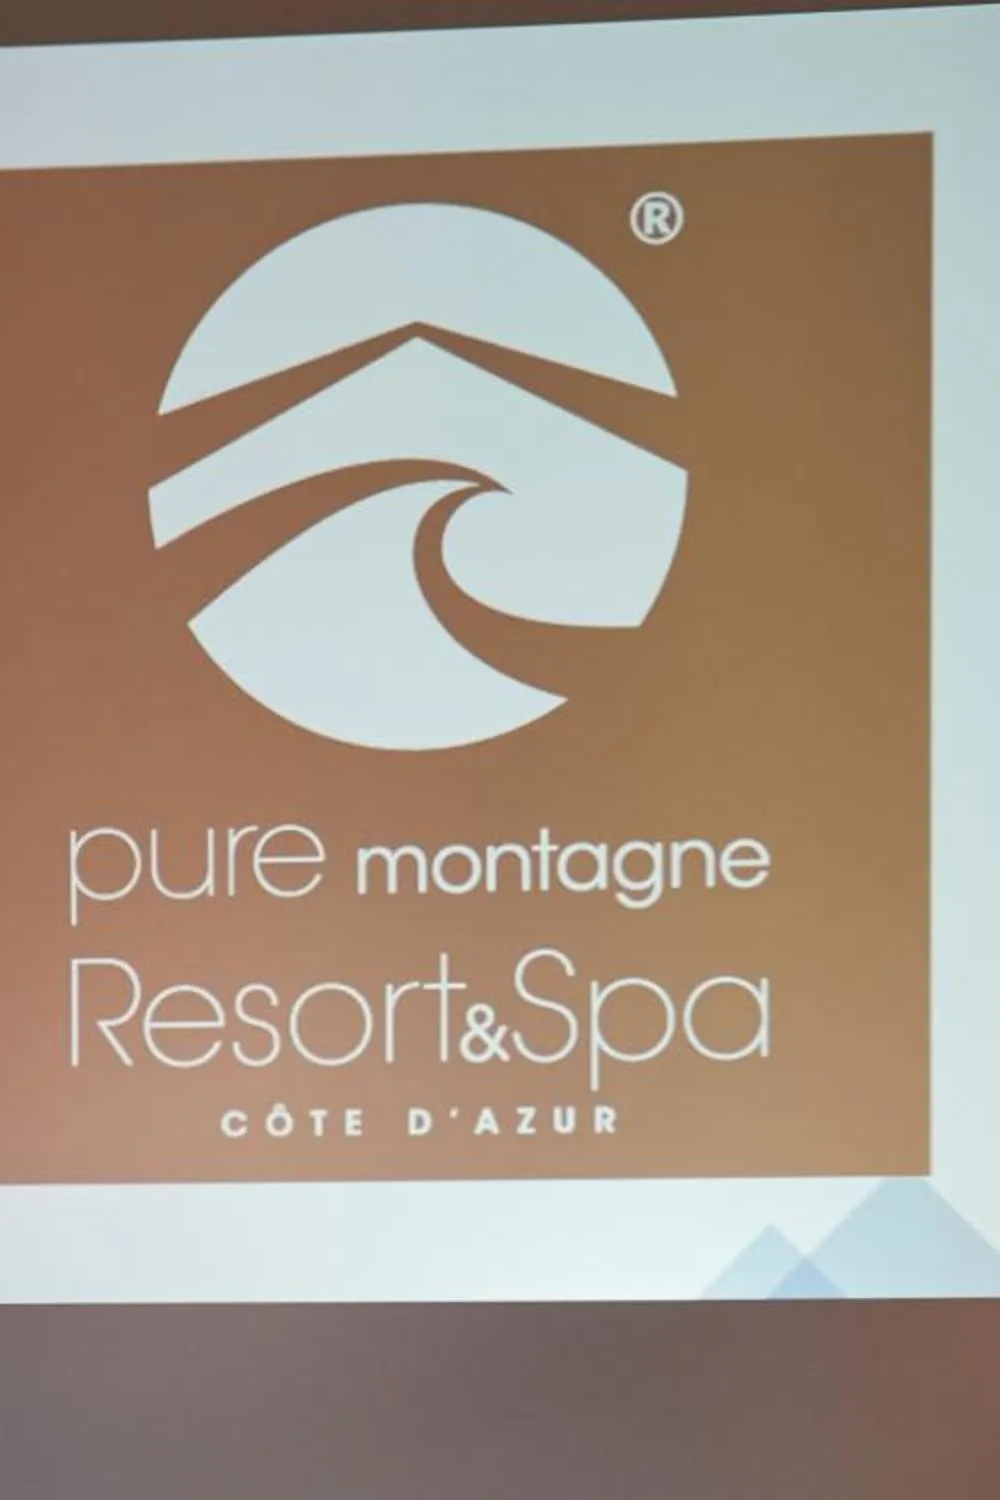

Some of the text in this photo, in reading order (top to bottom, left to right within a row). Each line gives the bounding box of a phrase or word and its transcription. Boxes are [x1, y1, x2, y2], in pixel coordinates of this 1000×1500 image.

[69, 823, 771, 927] pure montagne
[220, 1103, 617, 1138] CÔTE D'AZUR
